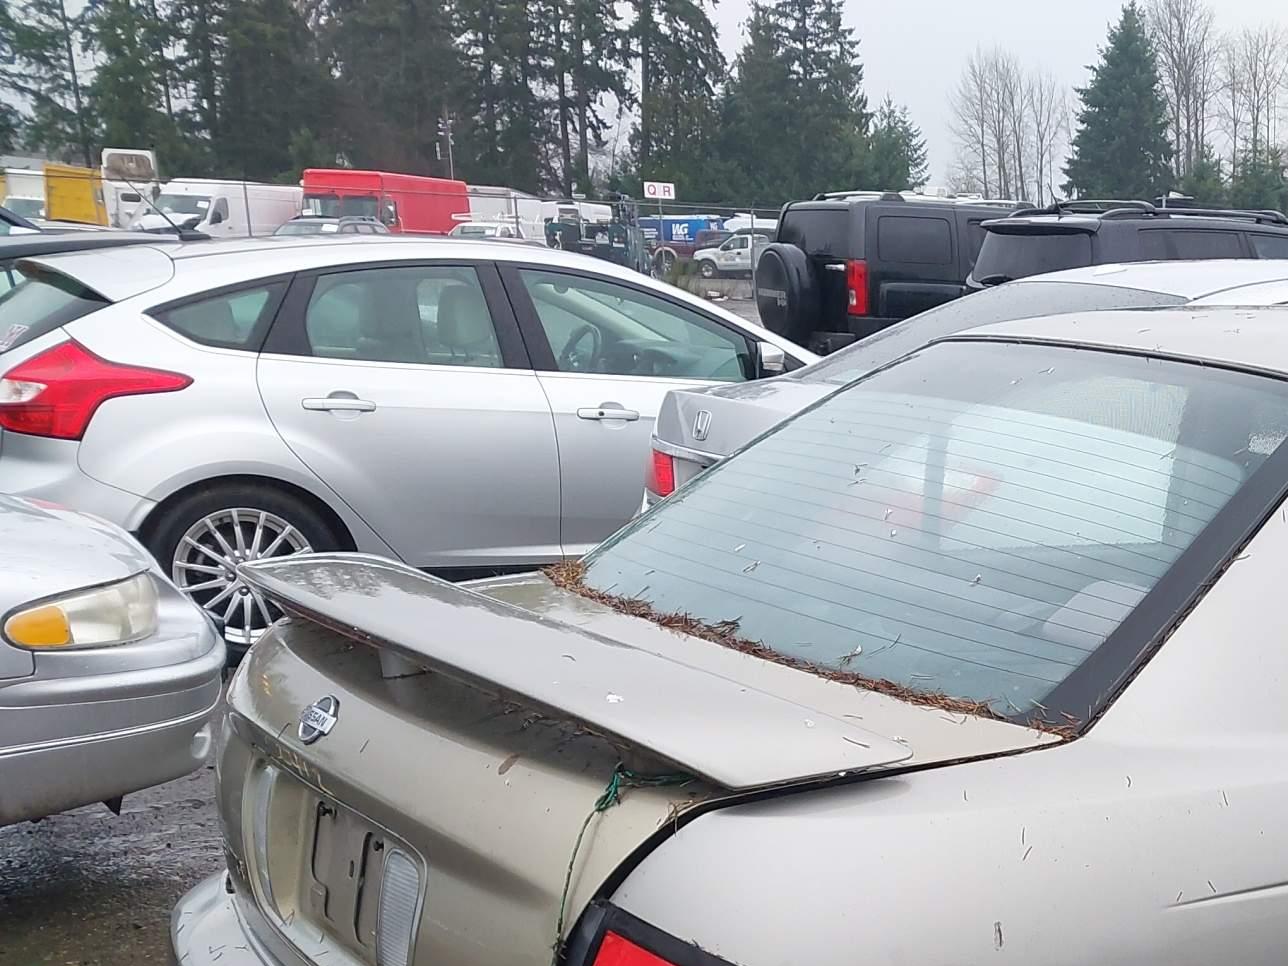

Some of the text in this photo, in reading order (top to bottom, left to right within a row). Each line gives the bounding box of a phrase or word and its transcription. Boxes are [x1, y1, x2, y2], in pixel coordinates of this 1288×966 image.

[647, 184, 671, 196] Q R
[672, 223, 689, 235] WG
